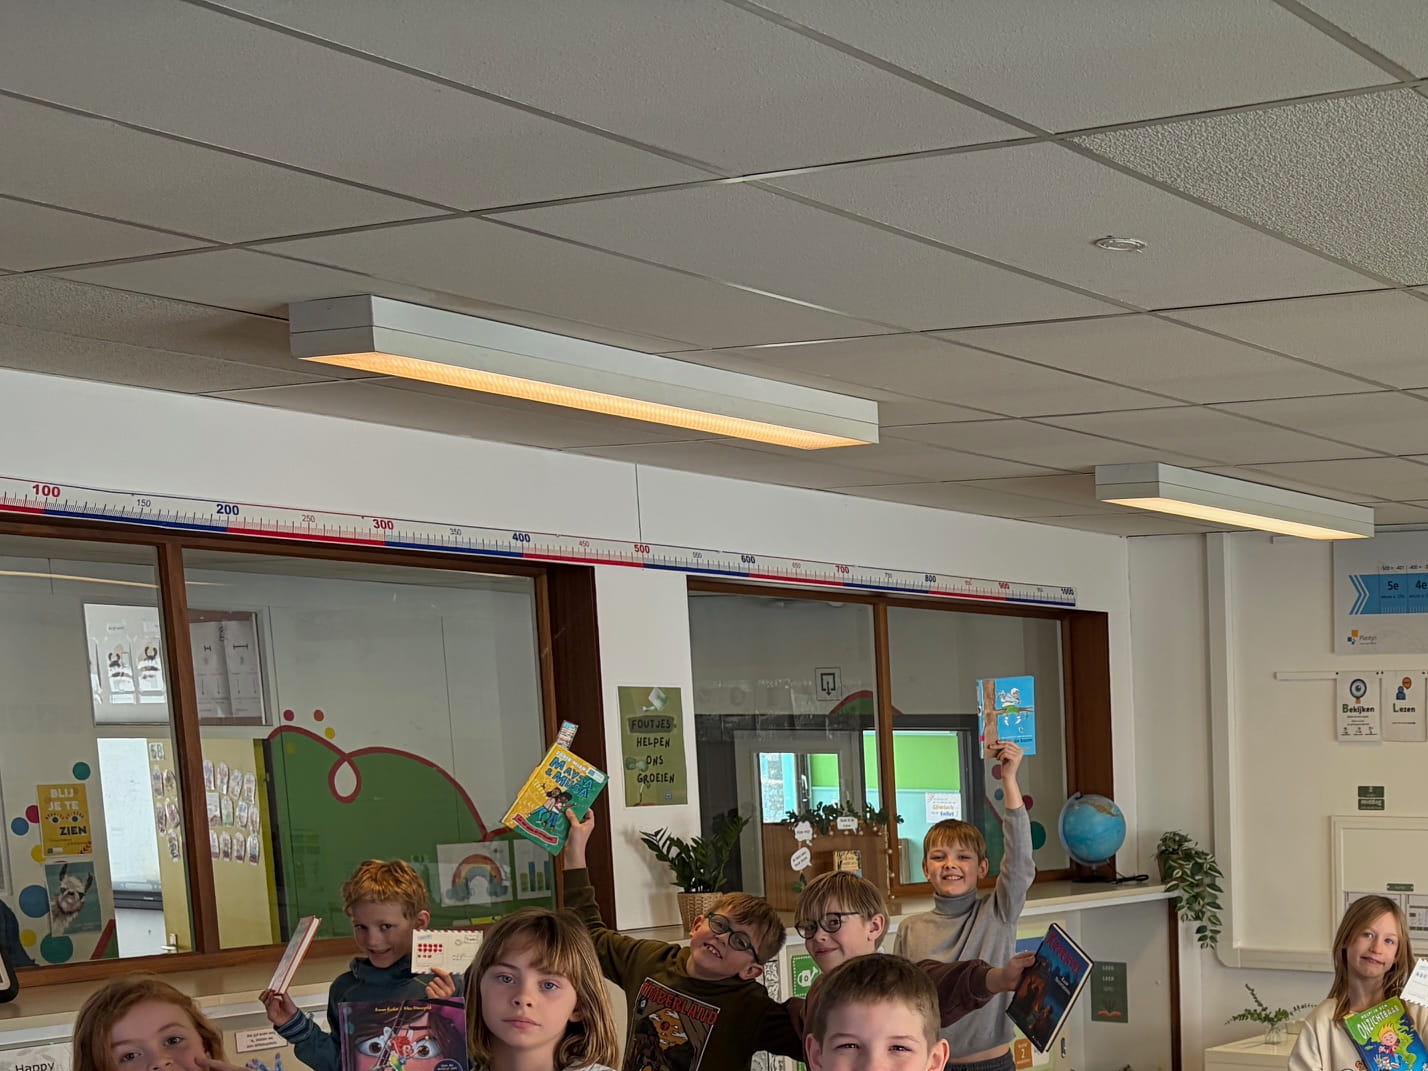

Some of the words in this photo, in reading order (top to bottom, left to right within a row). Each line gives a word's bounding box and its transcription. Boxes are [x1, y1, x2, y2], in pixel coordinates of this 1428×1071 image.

[33, 484, 61, 498] 100
[137, 499, 151, 508] 150
[216, 503, 240, 516] 200
[302, 514, 315, 523] 250
[372, 518, 394, 530] 300
[512, 532, 531, 543] 400
[634, 544, 650, 554] 500
[835, 565, 849, 574] 700
[925, 574, 936, 583] 800
[1388, 581, 1399, 590] 5e
[1416, 580, 1427, 589] 4e
[1342, 703, 1375, 715] Bekijken
[1392, 703, 1416, 713] Lezen
[631, 719, 671, 730] FOUTJES
[636, 737, 670, 748] HELPEN
[646, 755, 664, 766] ONS
[637, 773, 675, 784] GROEIEN
[50, 788, 74, 798] BLIJ
[48, 801, 62, 811] JE
[65, 800, 80, 810] TE
[59, 826, 87, 836] ZIEN
[1356, 1004, 1400, 1041] ONZICHTBAAR
